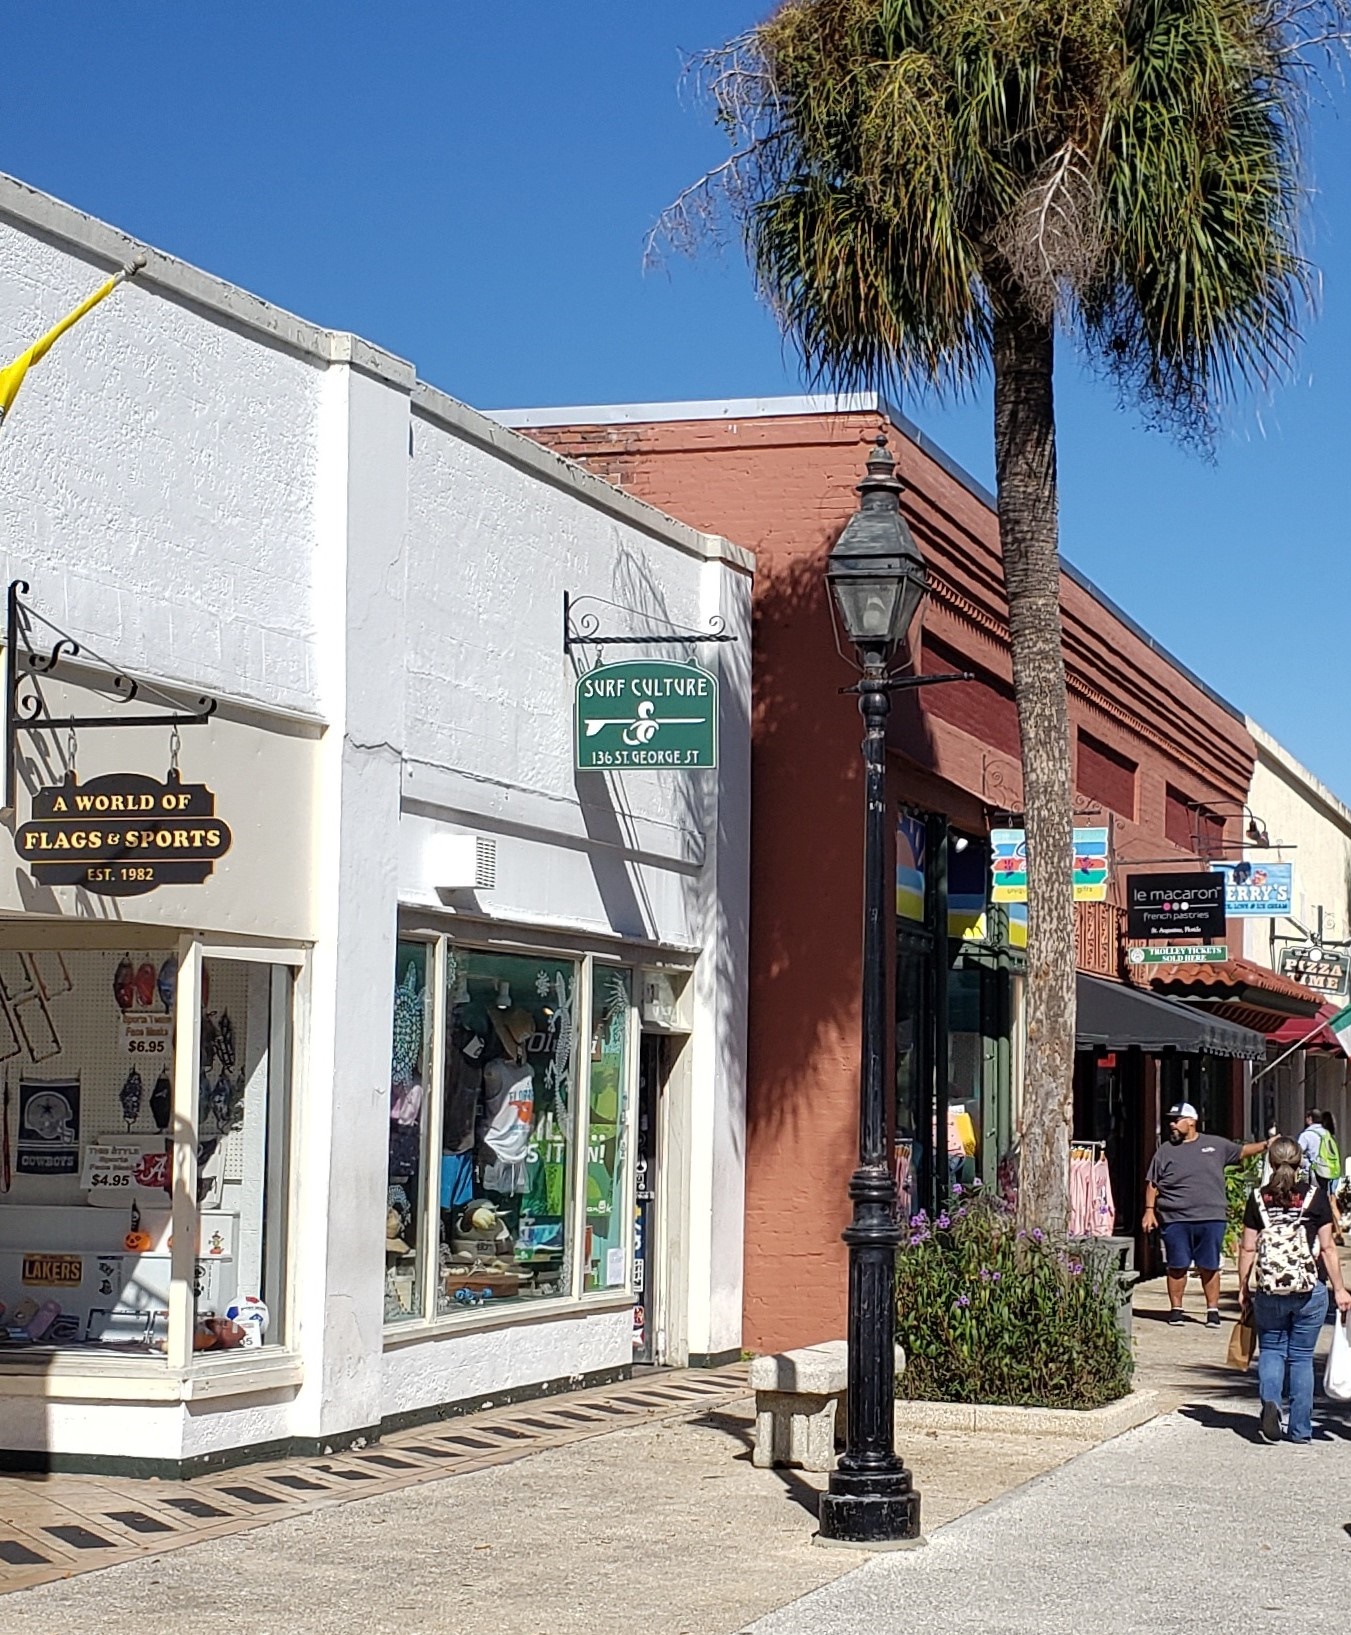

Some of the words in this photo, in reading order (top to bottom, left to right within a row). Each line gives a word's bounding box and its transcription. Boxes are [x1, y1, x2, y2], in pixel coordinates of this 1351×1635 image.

[584, 679, 626, 697] SURF
[631, 678, 708, 697] CULTURE
[592, 751, 613, 765] 136
[614, 751, 630, 765] ST.
[631, 750, 681, 764] GEORGE
[684, 750, 700, 764] ST
[52, 796, 68, 812] A
[75, 794, 155, 811] WORLD
[162, 794, 192, 810] OF
[24, 831, 102, 850] FLAGS
[106, 832, 121, 846] &
[124, 829, 221, 848] SPORTS
[87, 868, 116, 881] EST.
[120, 868, 154, 881] 1982
[1133, 888, 1148, 901] le
[1226, 883, 1288, 901] ERRY'S
[1143, 911, 1172, 922] french
[1173, 911, 1209, 921] pastries
[1162, 954, 1183, 962] SOLD
[1284, 958, 1343, 977] PIZZA
[1286, 971, 1339, 990] TIME
[128, 1041, 165, 1053] $6.95
[21, 1155, 75, 1167] COWBOYS
[91, 1174, 131, 1187] $4.95
[24, 1261, 81, 1280] LAKERS
